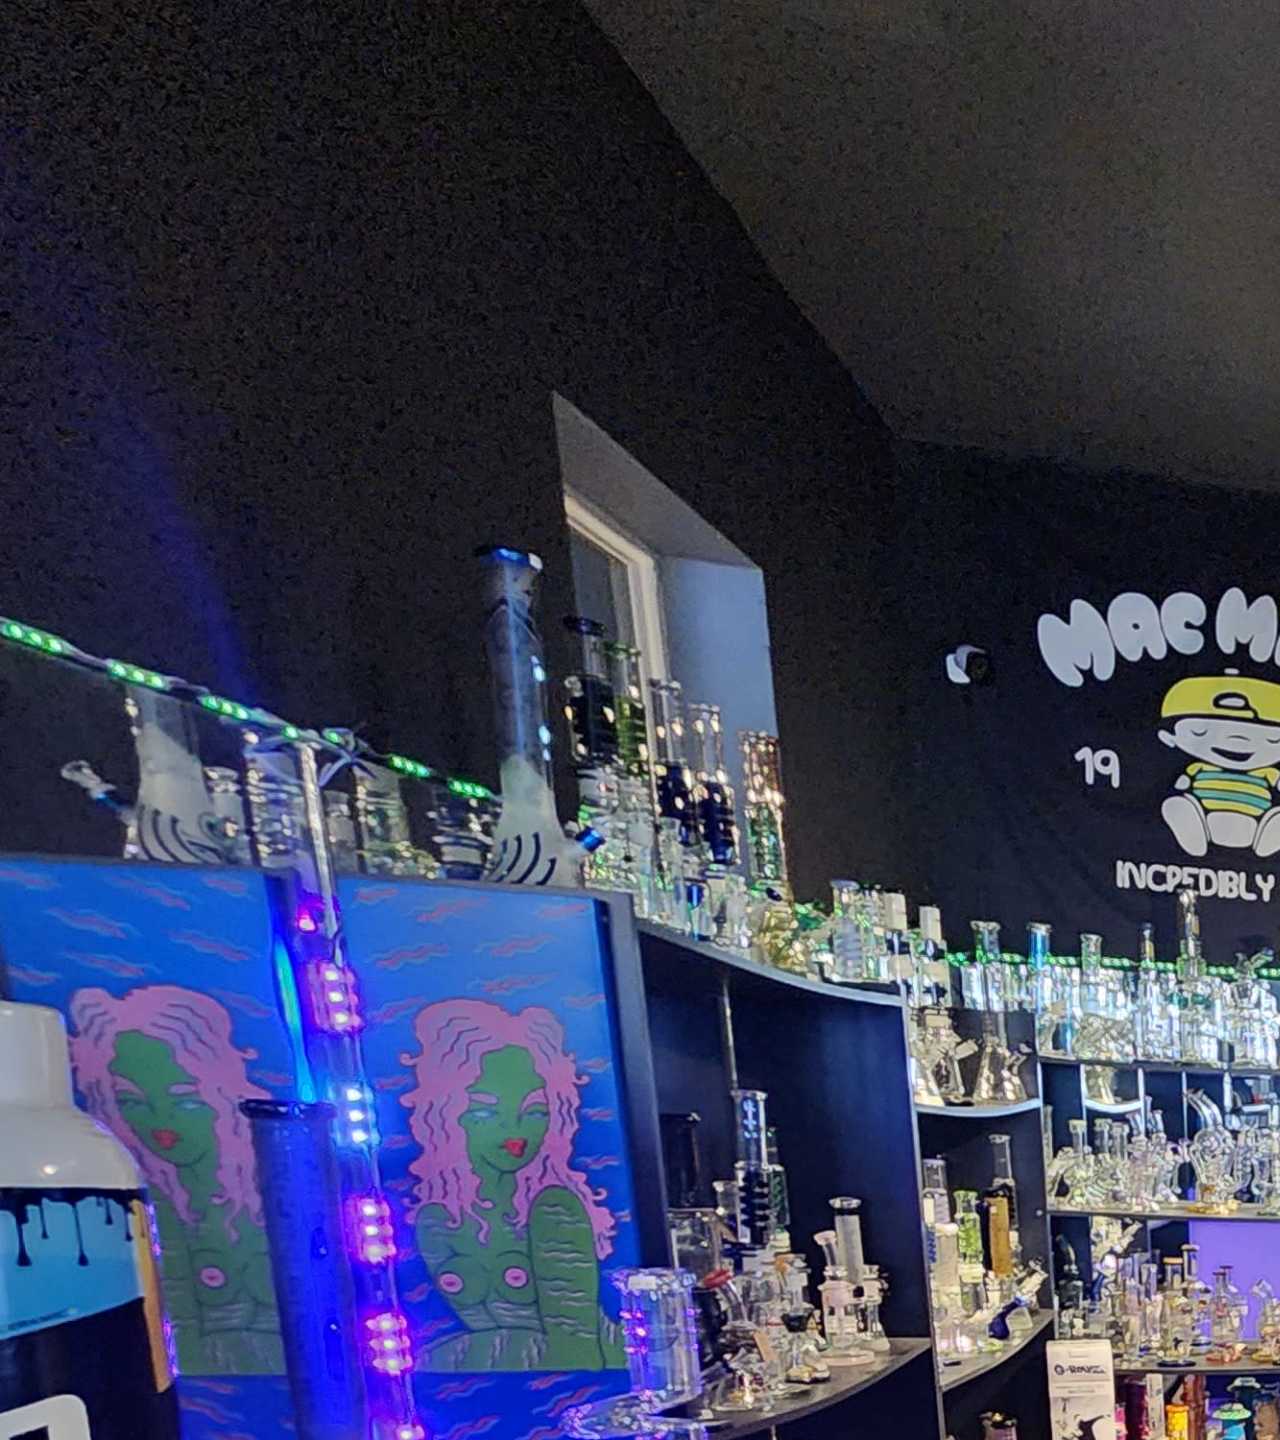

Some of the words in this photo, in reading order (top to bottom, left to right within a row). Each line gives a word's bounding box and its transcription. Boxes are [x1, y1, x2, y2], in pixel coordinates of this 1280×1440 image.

[1037, 591, 1206, 688] MAC
[1073, 745, 1121, 789] 19
[1116, 860, 1275, 903] INCREDIBLY
